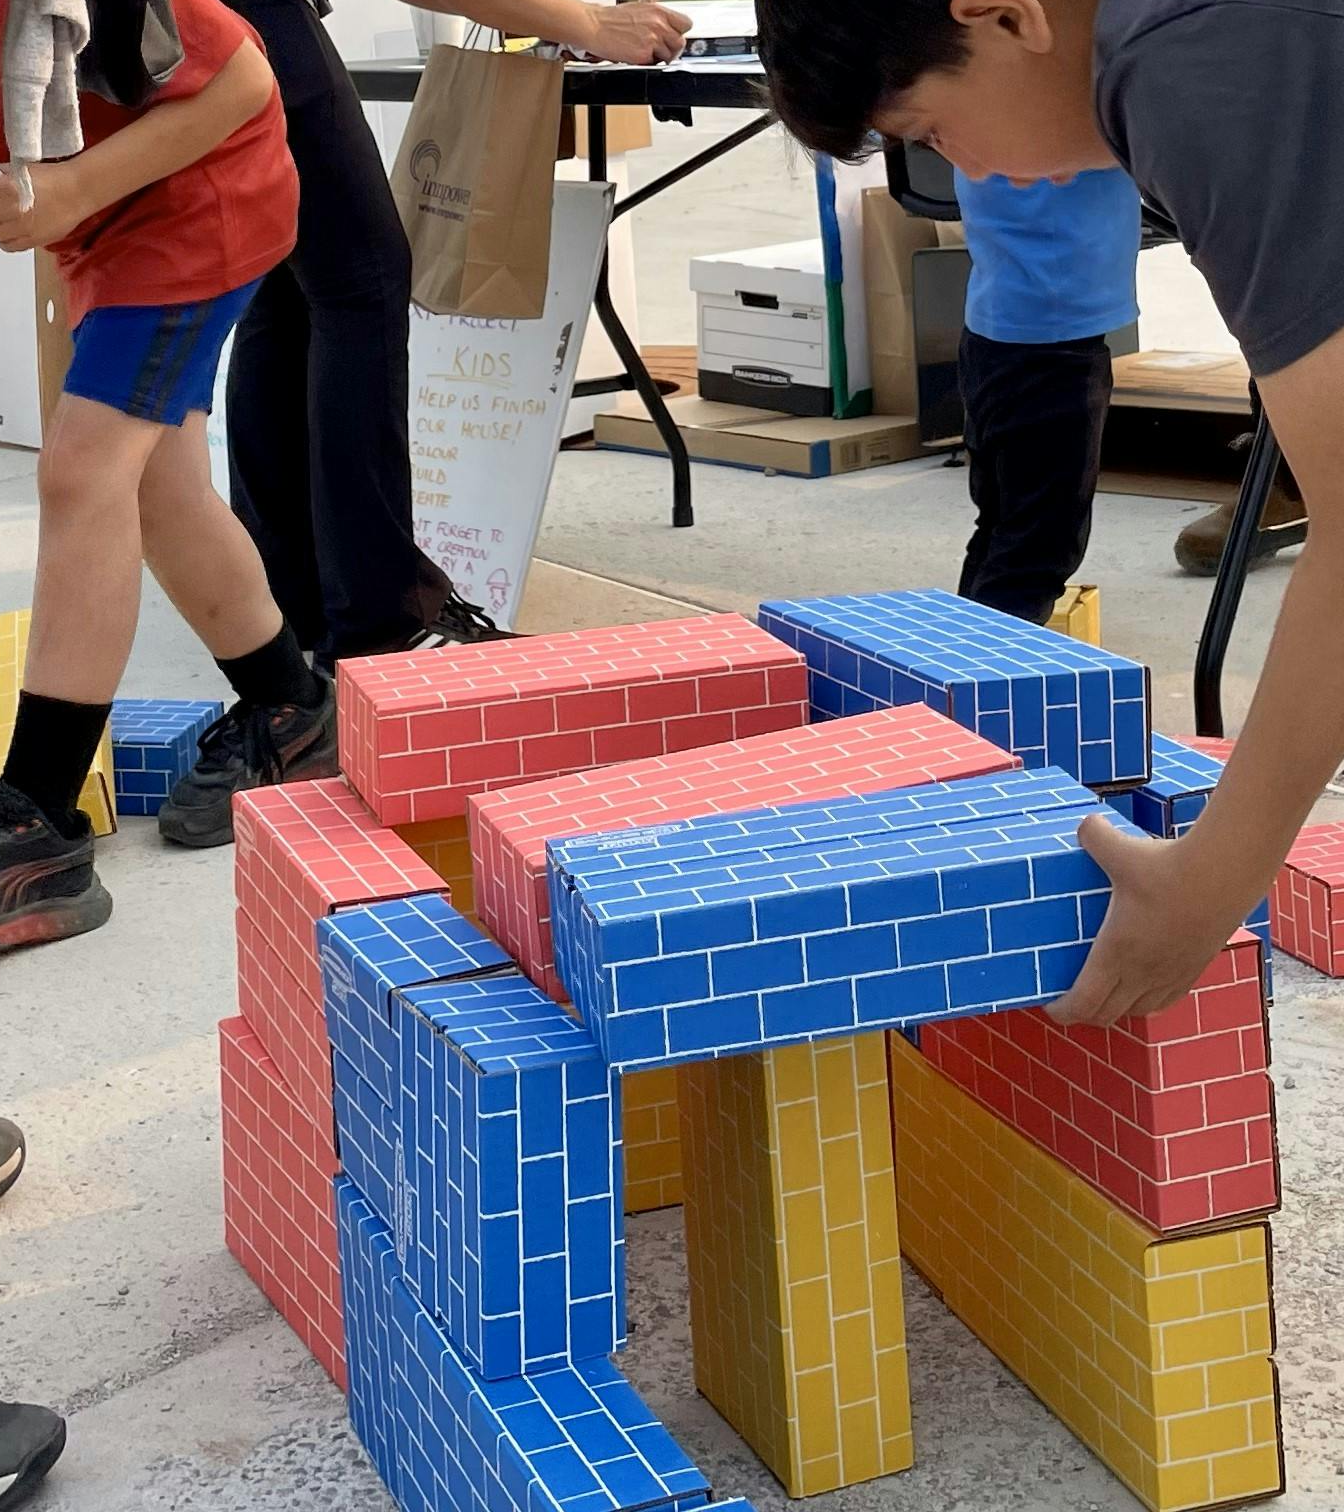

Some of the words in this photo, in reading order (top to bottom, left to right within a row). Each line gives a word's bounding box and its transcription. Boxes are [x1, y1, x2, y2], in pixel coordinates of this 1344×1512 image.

[452, 346, 513, 377] KIDS
[416, 386, 456, 409] HELP
[462, 395, 480, 411] US
[491, 396, 547, 414] FINISH
[416, 418, 446, 433] OUR
[461, 420, 523, 440] HOUSE!
[411, 463, 447, 485] UILD
[437, 521, 483, 542] FORGET
[490, 528, 504, 543] TO
[437, 541, 489, 560] CREATION
[441, 556, 457, 573] BY
[464, 561, 474, 575] A
